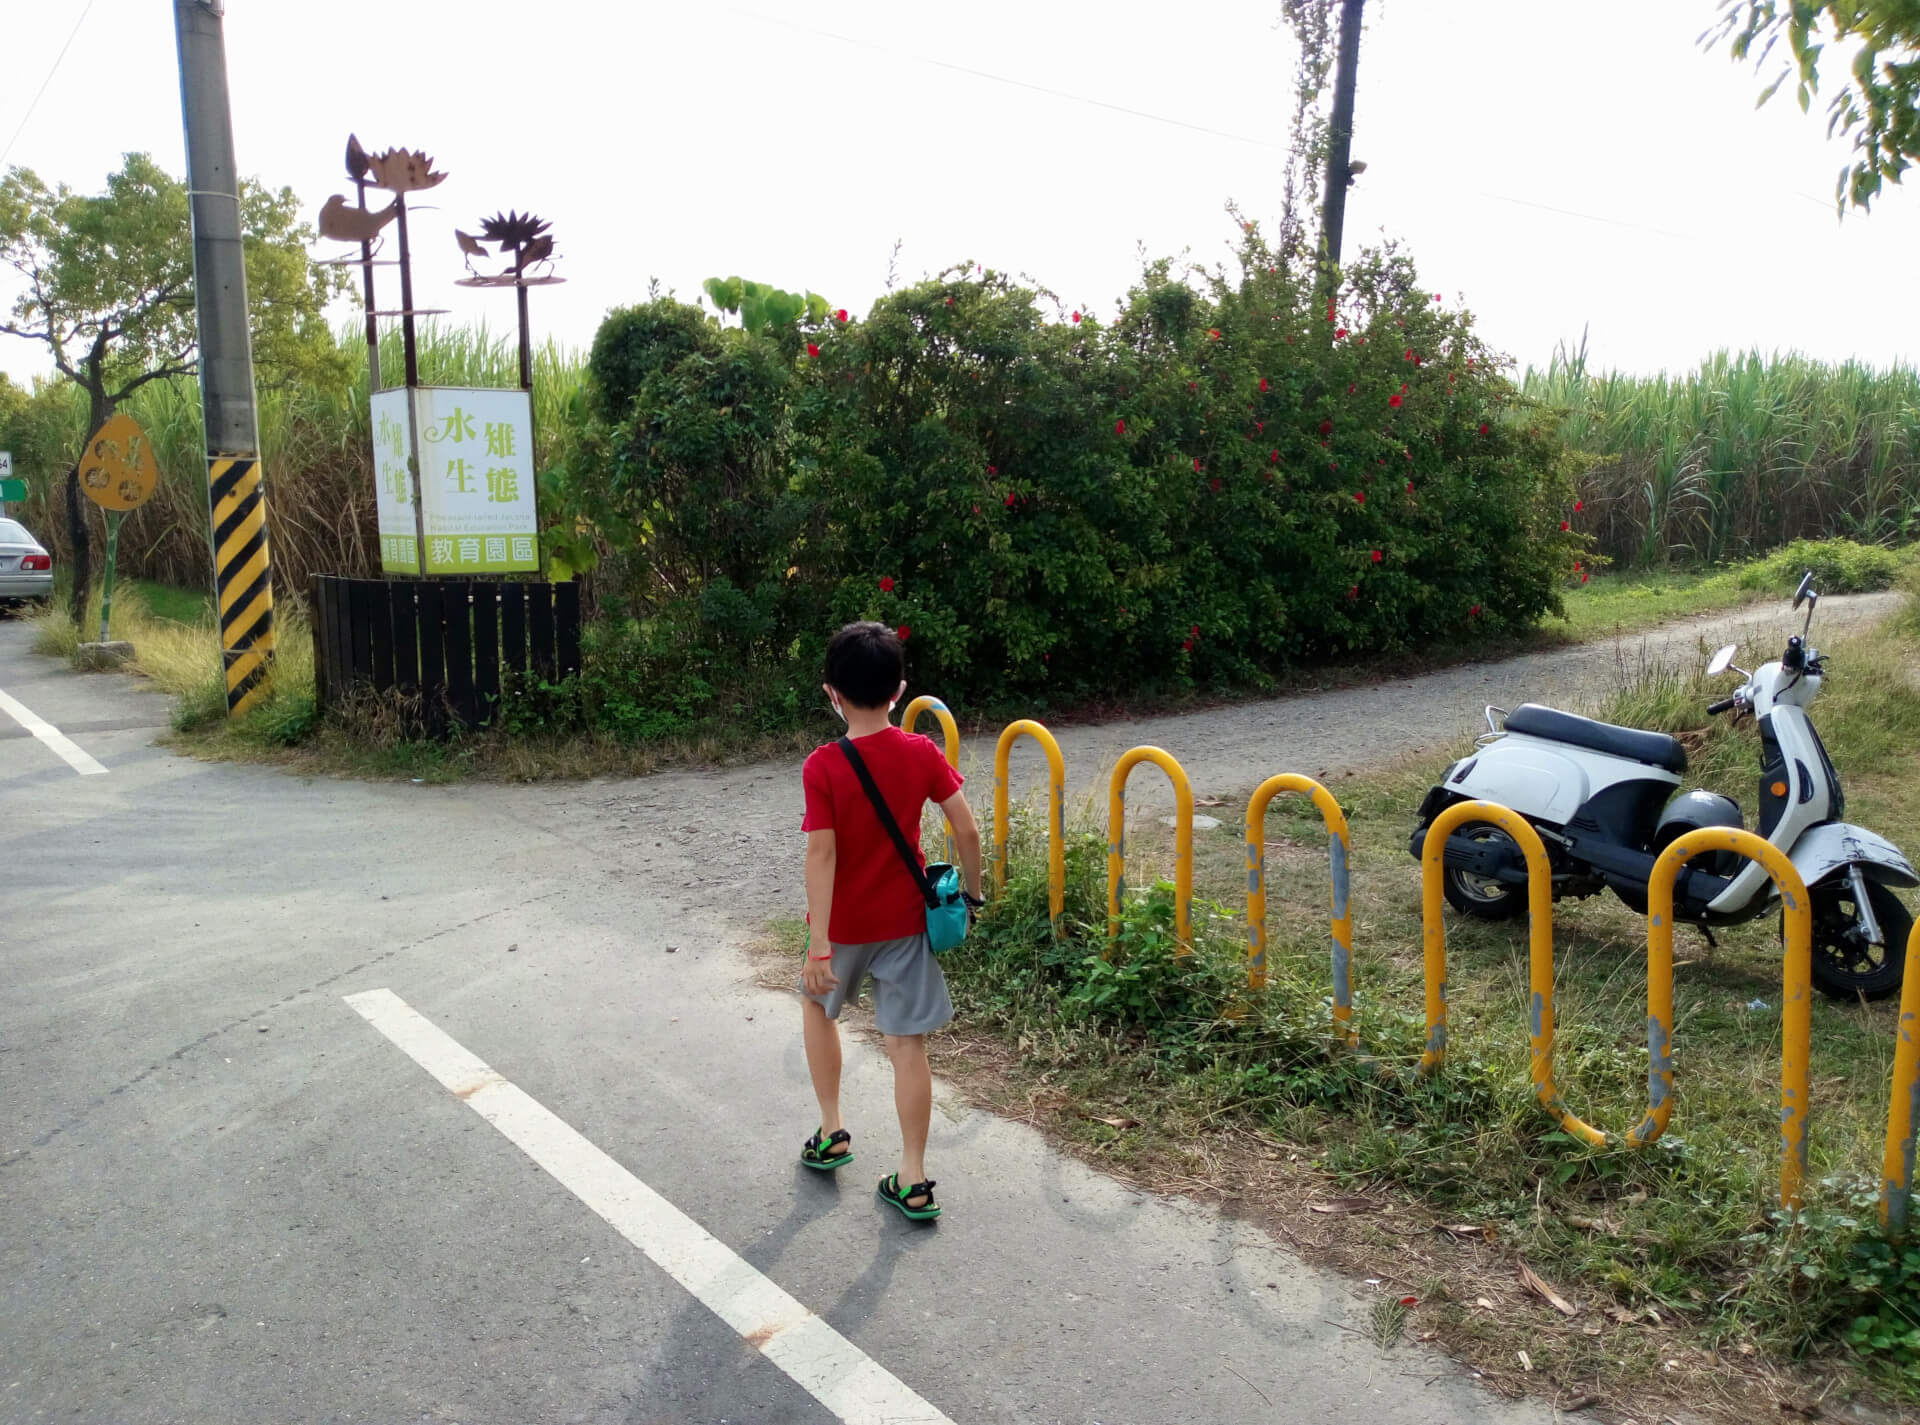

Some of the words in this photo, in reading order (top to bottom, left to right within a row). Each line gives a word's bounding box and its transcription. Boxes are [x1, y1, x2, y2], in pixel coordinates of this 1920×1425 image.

[423, 407, 516, 459] 水雉
[445, 458, 519, 503] 生態
[431, 536, 534, 565] 教育園區
